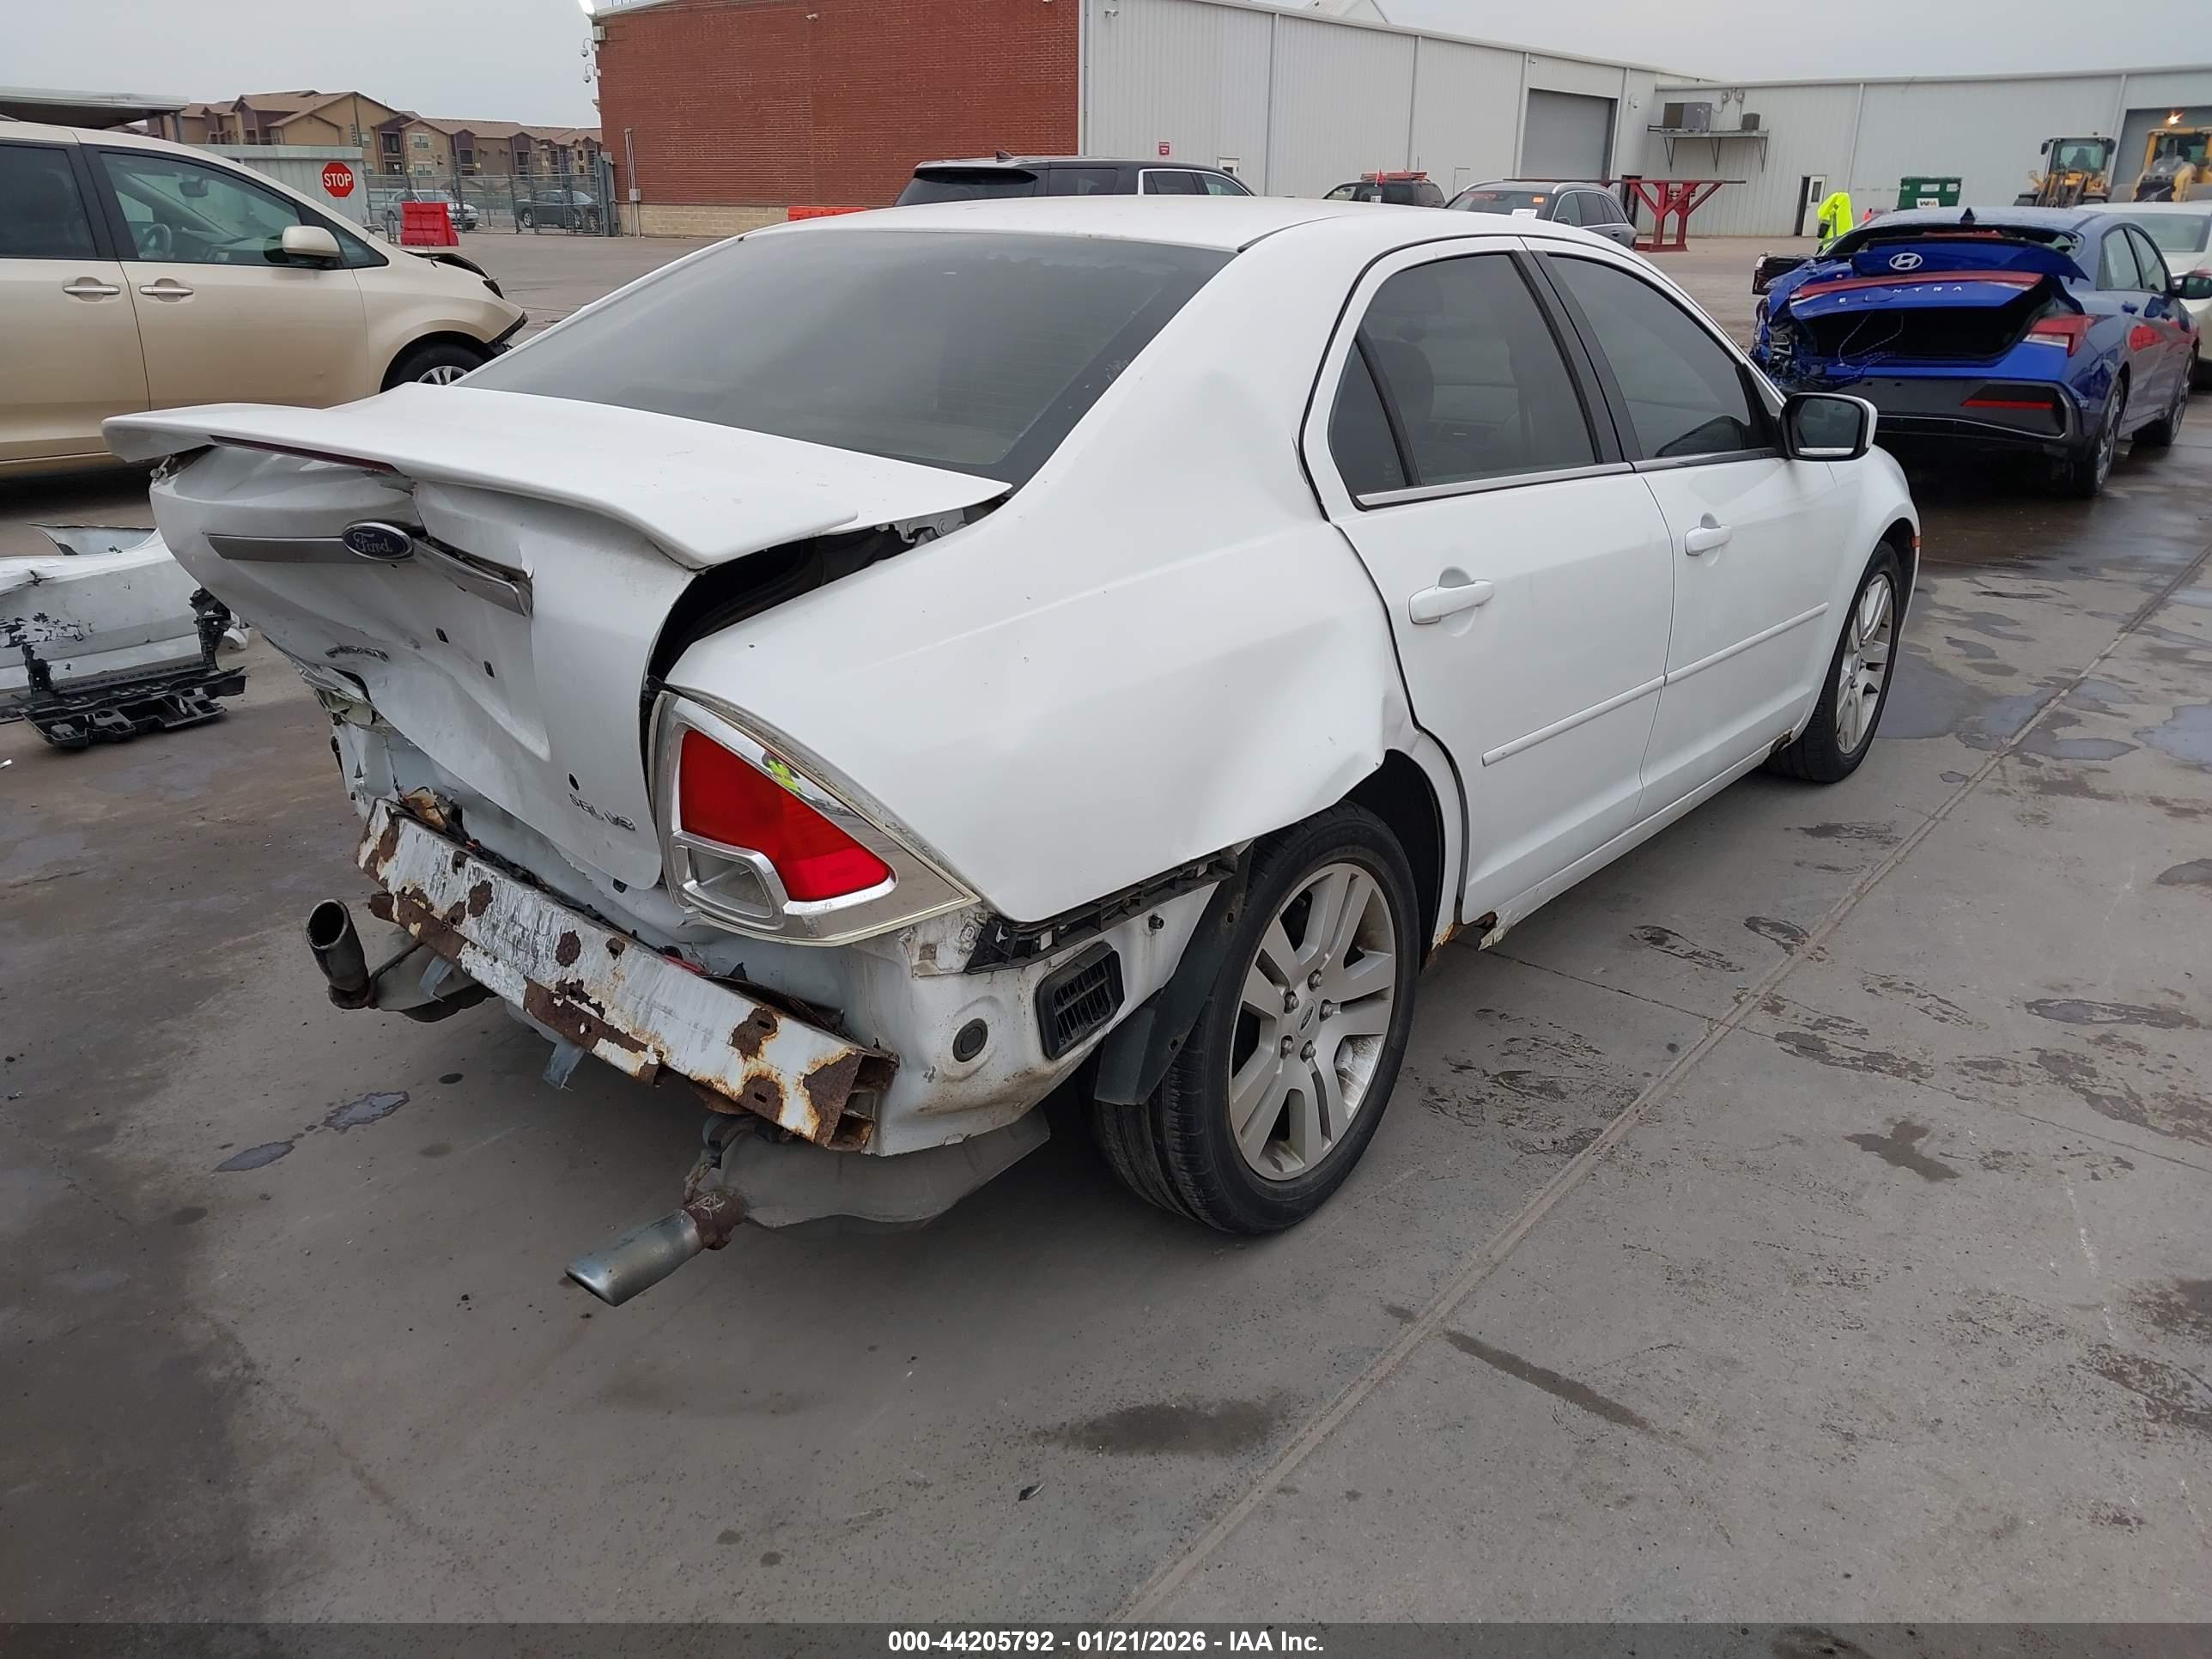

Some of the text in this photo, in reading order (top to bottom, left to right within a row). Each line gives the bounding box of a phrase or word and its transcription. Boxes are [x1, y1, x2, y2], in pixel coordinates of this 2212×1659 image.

[324, 173, 352, 187] STOP
[1838, 285, 1963, 303] ELNTRA
[352, 532, 393, 552] Ford
[568, 793, 605, 820] SEL
